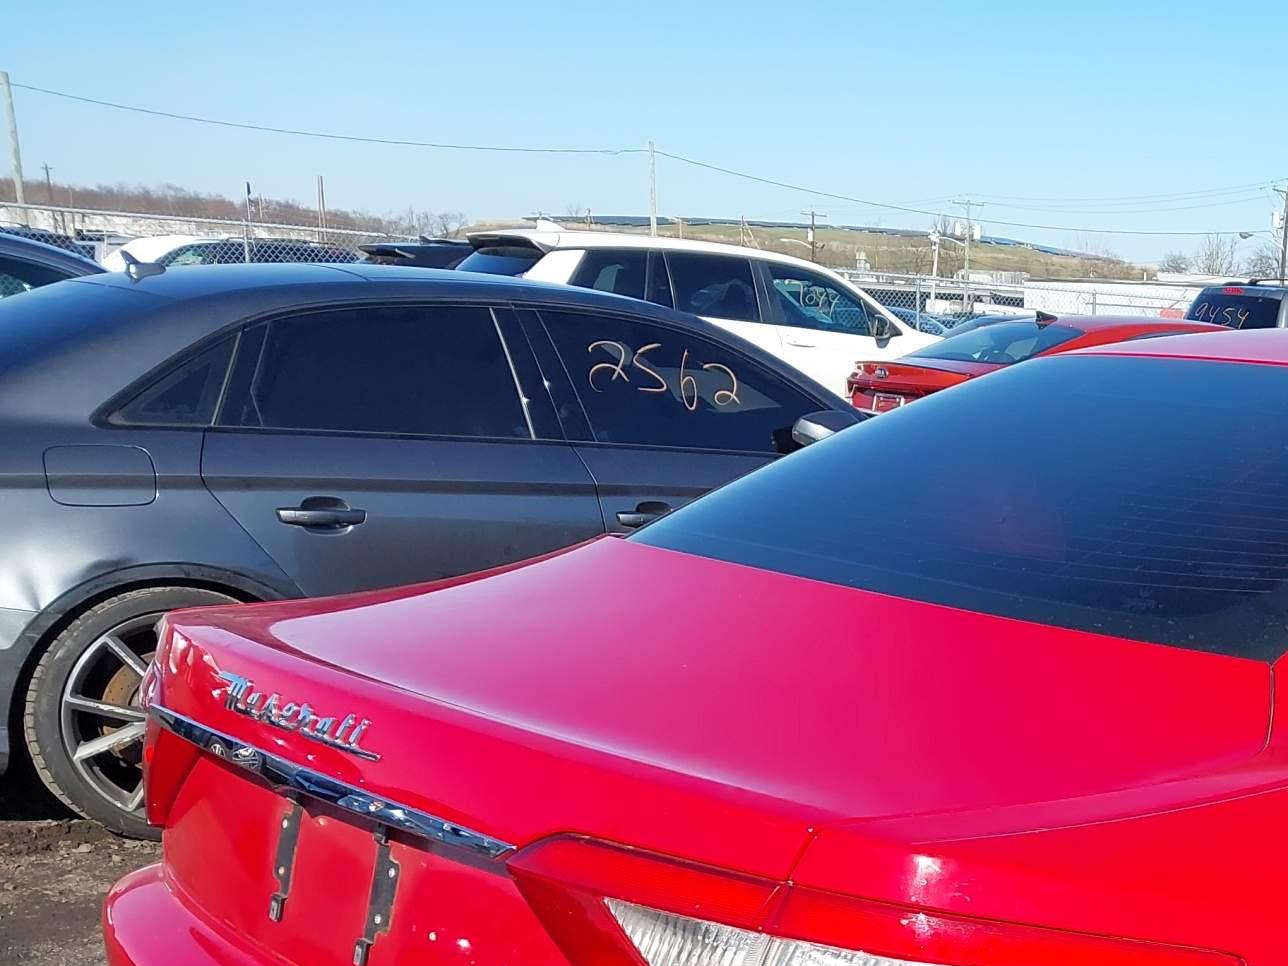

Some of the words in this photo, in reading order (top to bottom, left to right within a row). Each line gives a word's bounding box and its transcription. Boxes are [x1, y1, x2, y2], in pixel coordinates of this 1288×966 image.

[1195, 302, 1249, 329] 9454
[588, 341, 740, 411] 2562
[214, 671, 381, 762] Maserati
